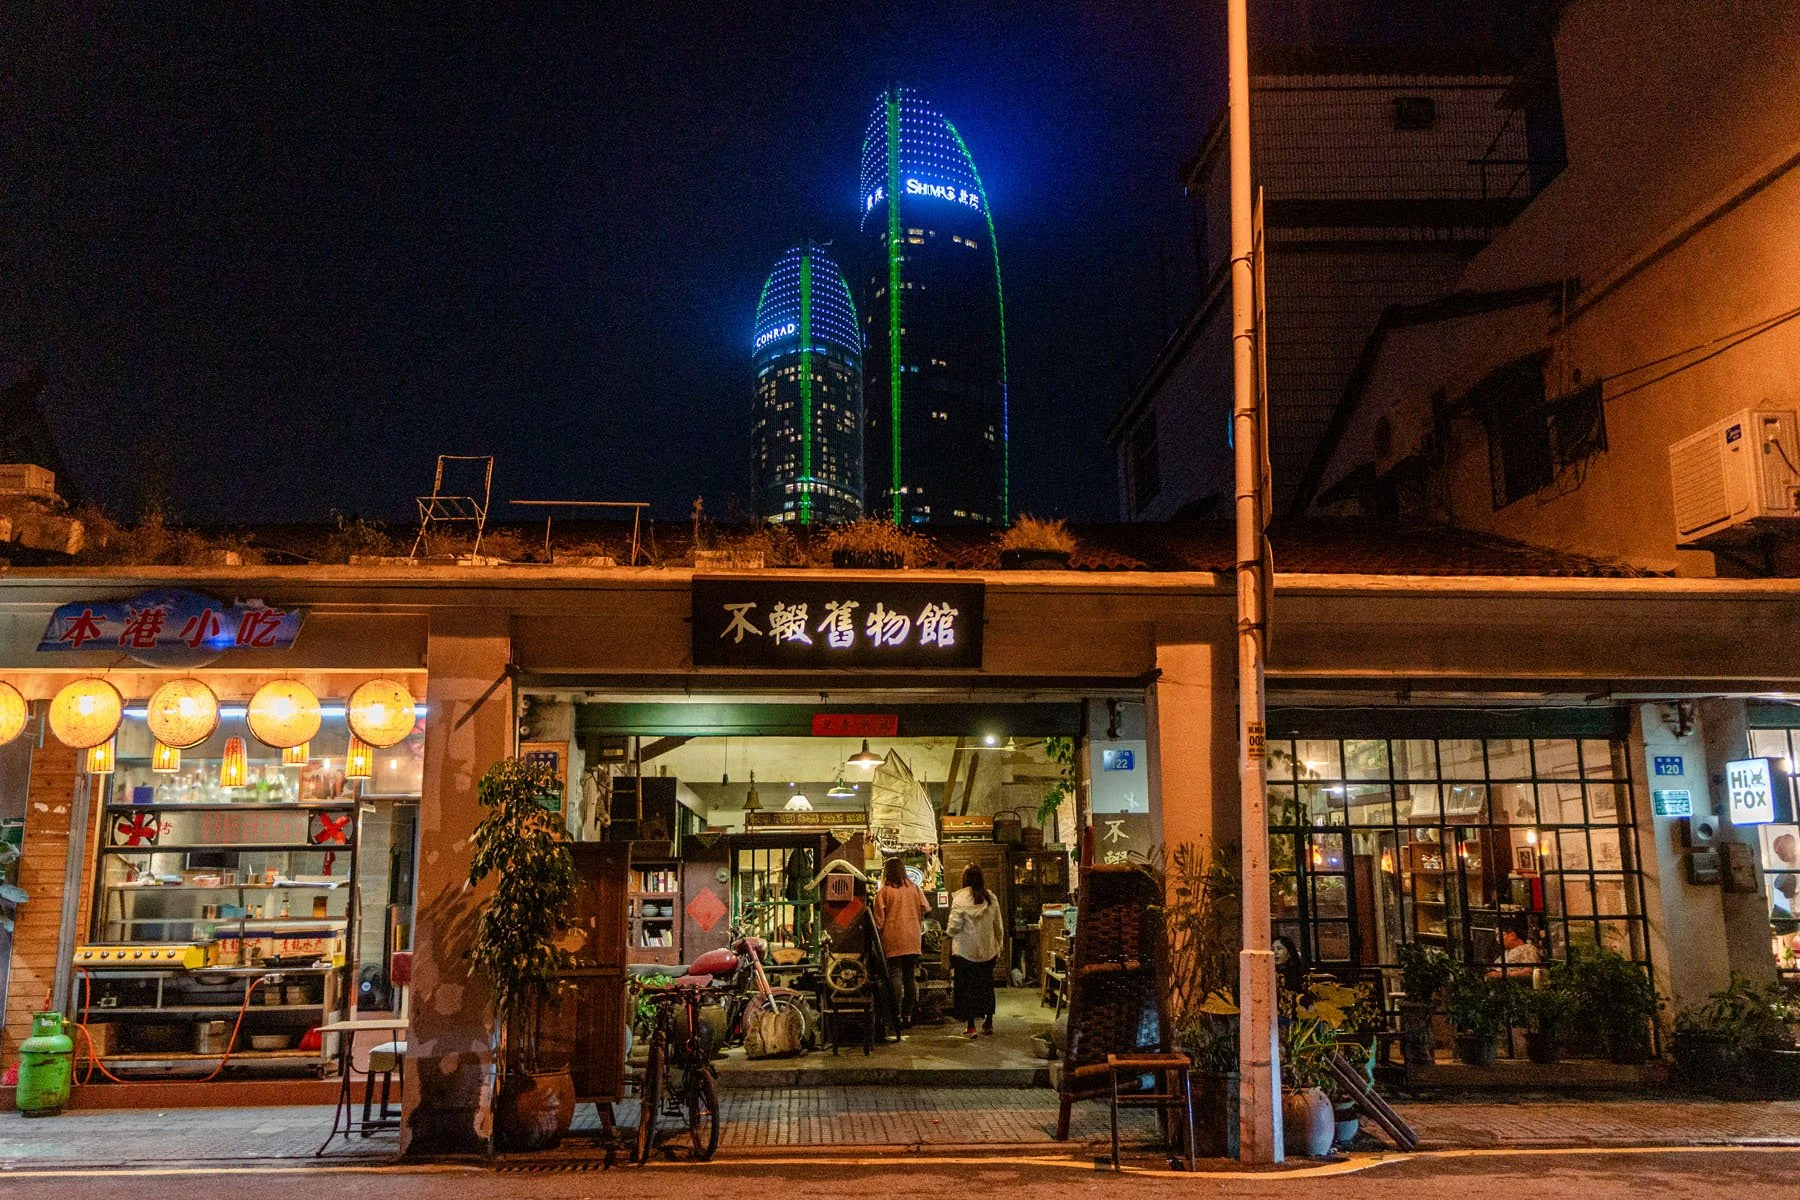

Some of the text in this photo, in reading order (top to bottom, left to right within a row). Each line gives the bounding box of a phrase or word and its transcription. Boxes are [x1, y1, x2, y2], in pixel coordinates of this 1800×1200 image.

[756, 323, 795, 347] CONRAD
[59, 607, 286, 649] 本港小吃
[720, 600, 959, 648] 不輟舊物館
[1112, 758, 1128, 769] 122
[1659, 764, 1679, 775] 120
[1734, 790, 1767, 810] FOX
